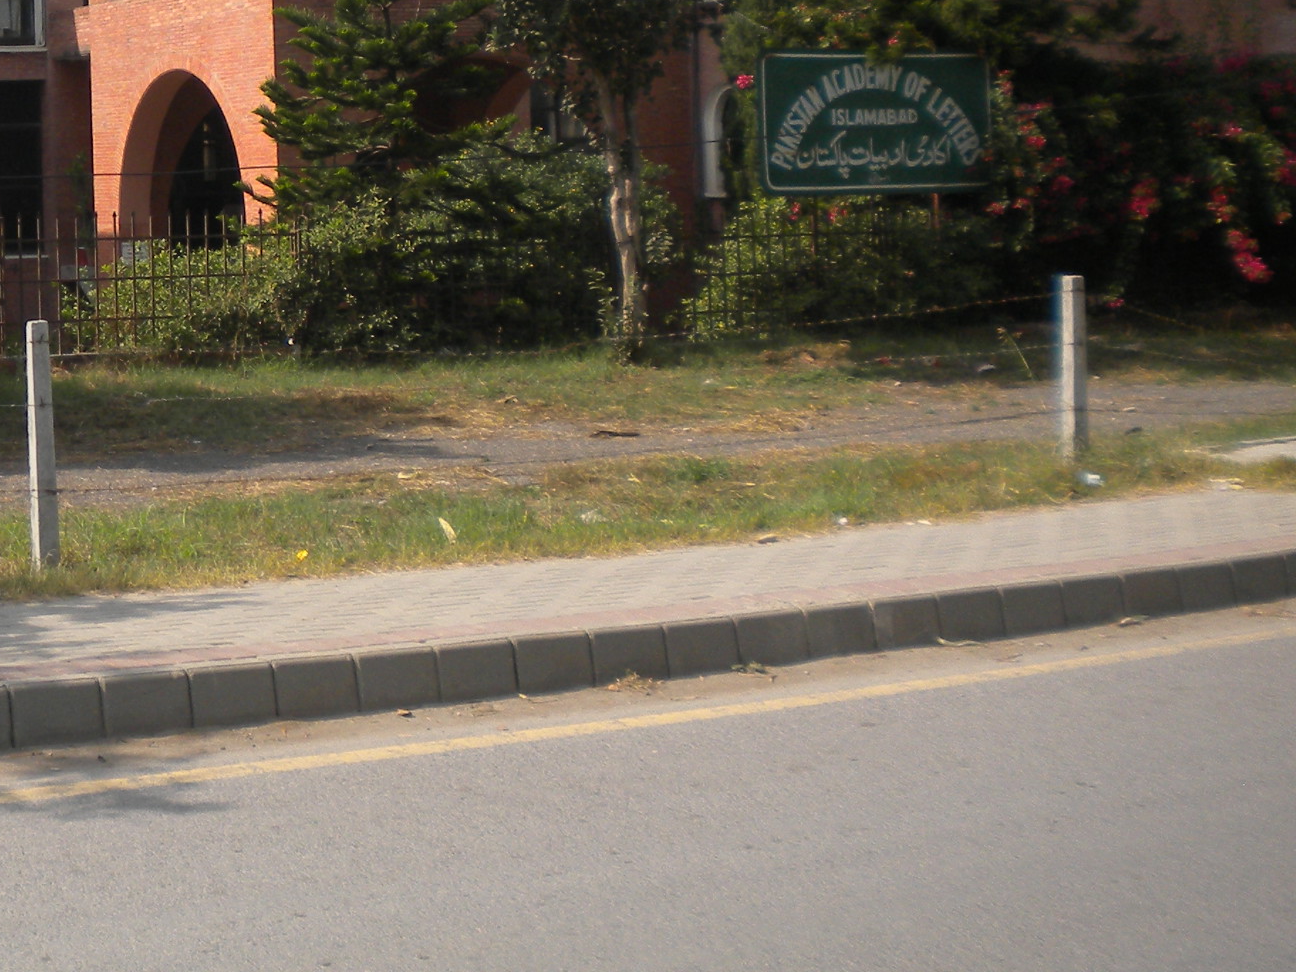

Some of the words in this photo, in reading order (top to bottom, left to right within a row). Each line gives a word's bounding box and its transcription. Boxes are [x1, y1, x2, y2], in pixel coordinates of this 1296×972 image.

[770, 85, 826, 170] PAKISTAN
[822, 63, 903, 102] ACADEMY
[904, 71, 931, 101] OF
[926, 87, 984, 166] LETTERS
[831, 108, 919, 126] ISLAMABAD
